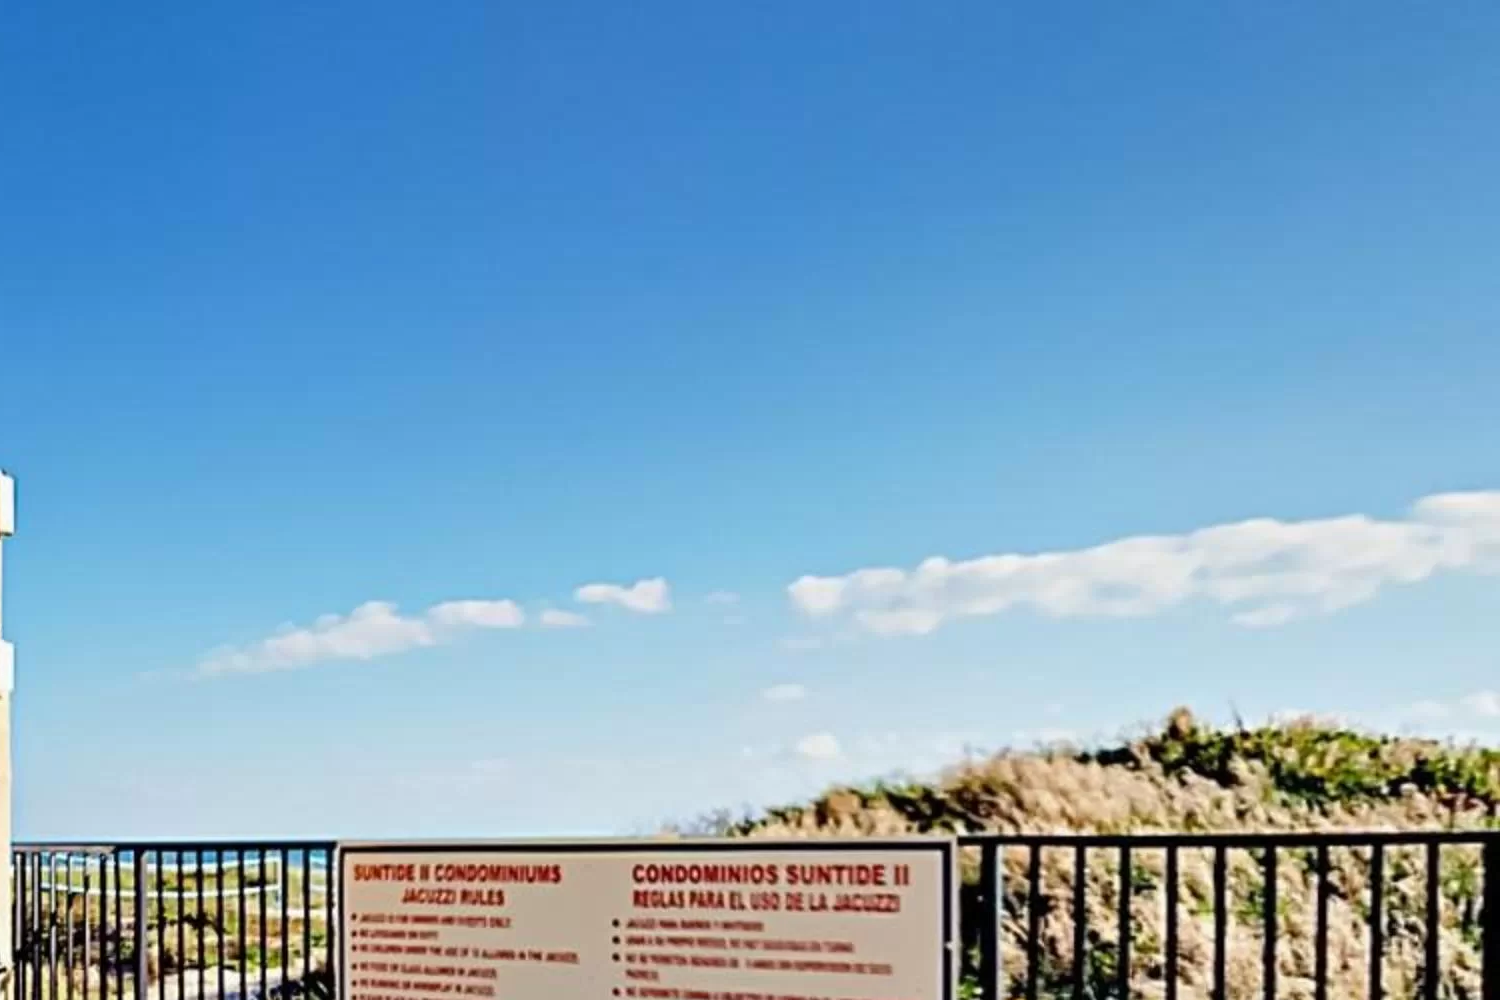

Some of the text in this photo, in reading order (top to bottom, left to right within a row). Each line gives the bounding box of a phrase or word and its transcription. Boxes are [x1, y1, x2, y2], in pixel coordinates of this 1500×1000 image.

[354, 864, 562, 884] SUNTIDE II CONDOMINIUMS
[632, 864, 909, 886] CONDOMINIOS SUNTIDE II
[402, 887, 505, 906] JACUZZI RULES
[633, 890, 901, 913] REGLAS PARA EL USO DE LA JACUZZI
